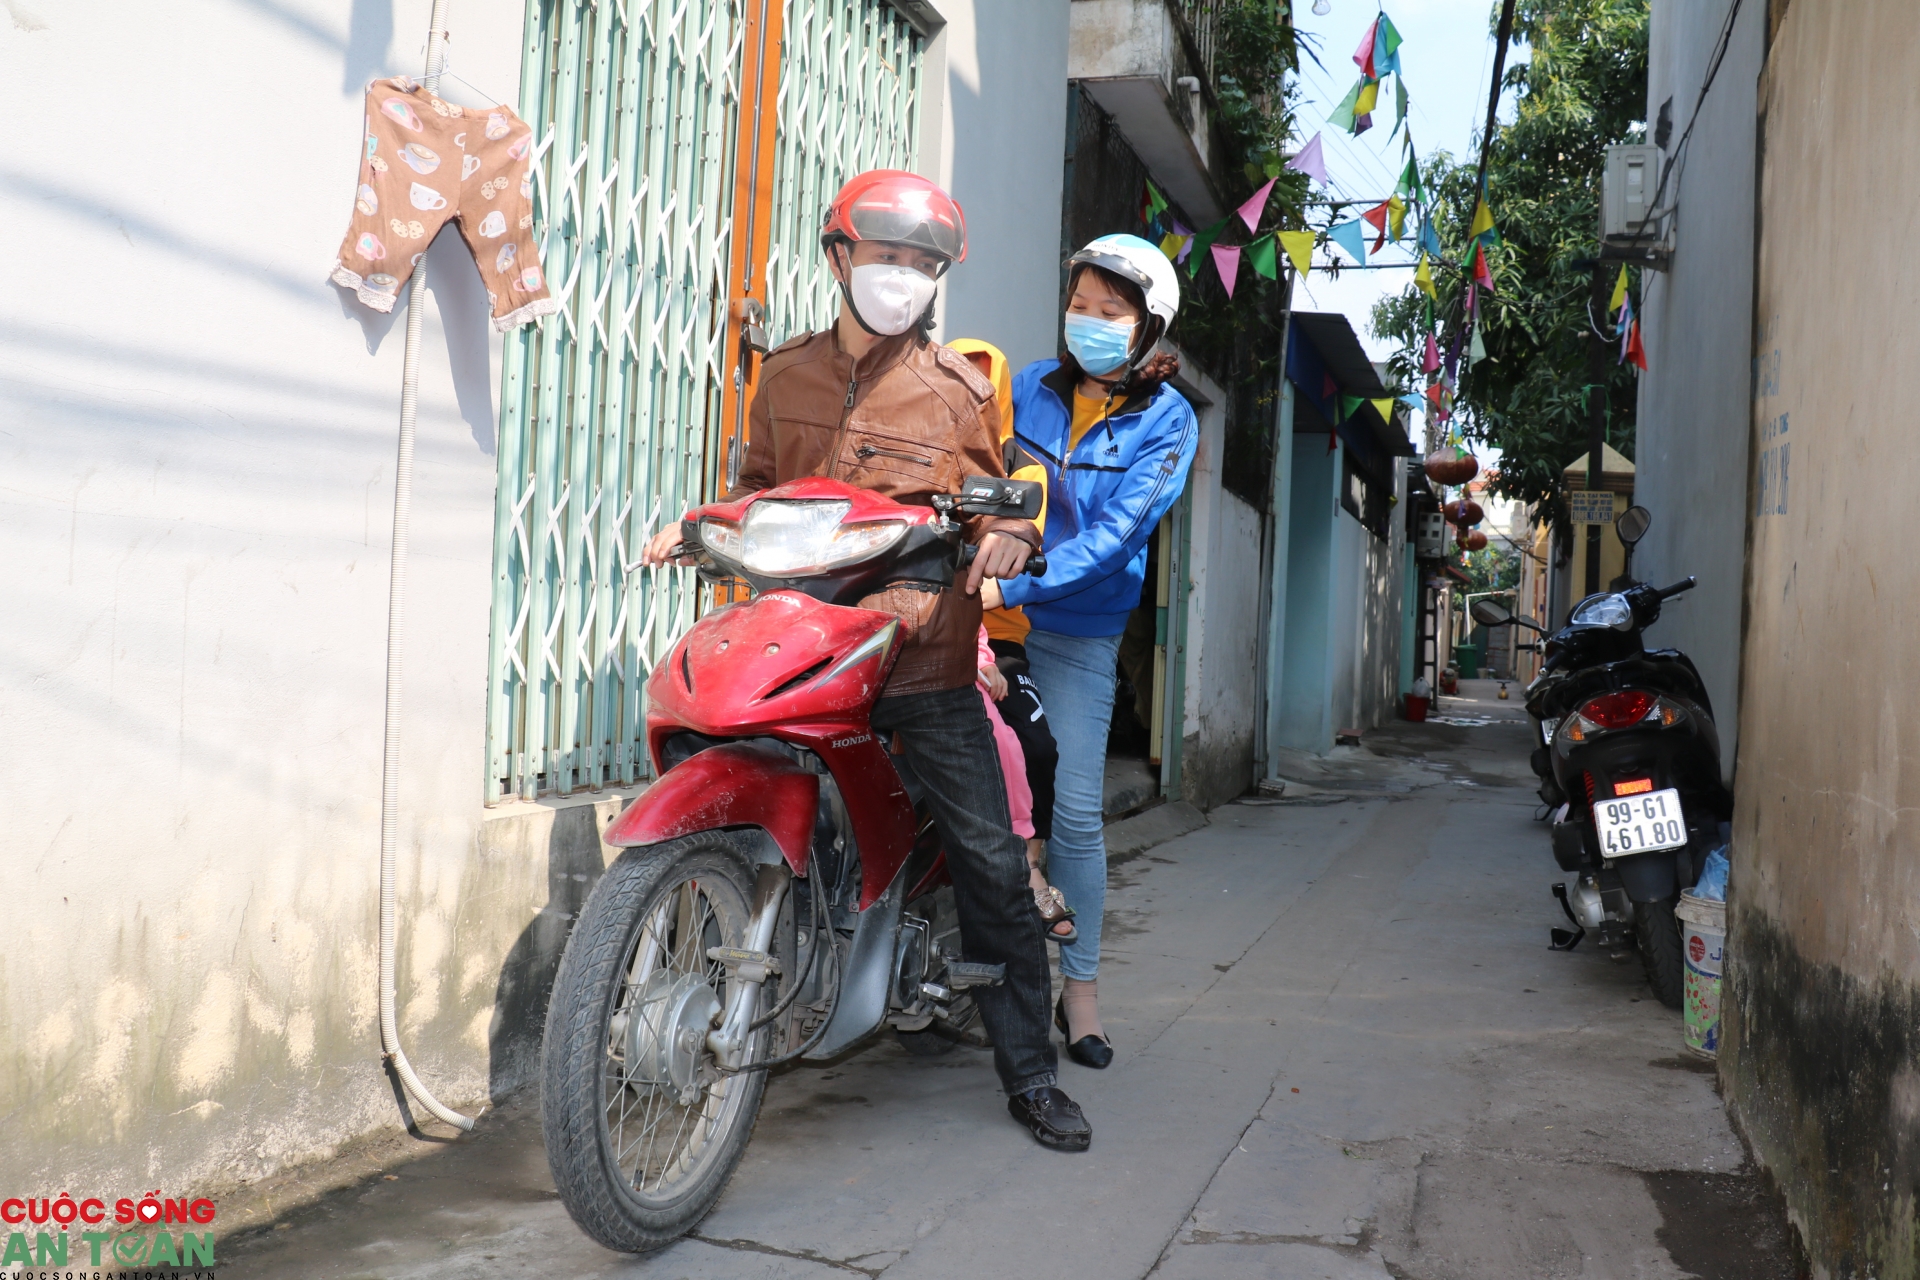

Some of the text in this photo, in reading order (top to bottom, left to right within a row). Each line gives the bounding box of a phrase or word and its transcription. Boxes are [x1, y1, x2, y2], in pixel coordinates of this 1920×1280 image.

[831, 734, 872, 748] HONDA
[1607, 795, 1667, 825] 99-G1
[1606, 819, 1680, 853] 461.80
